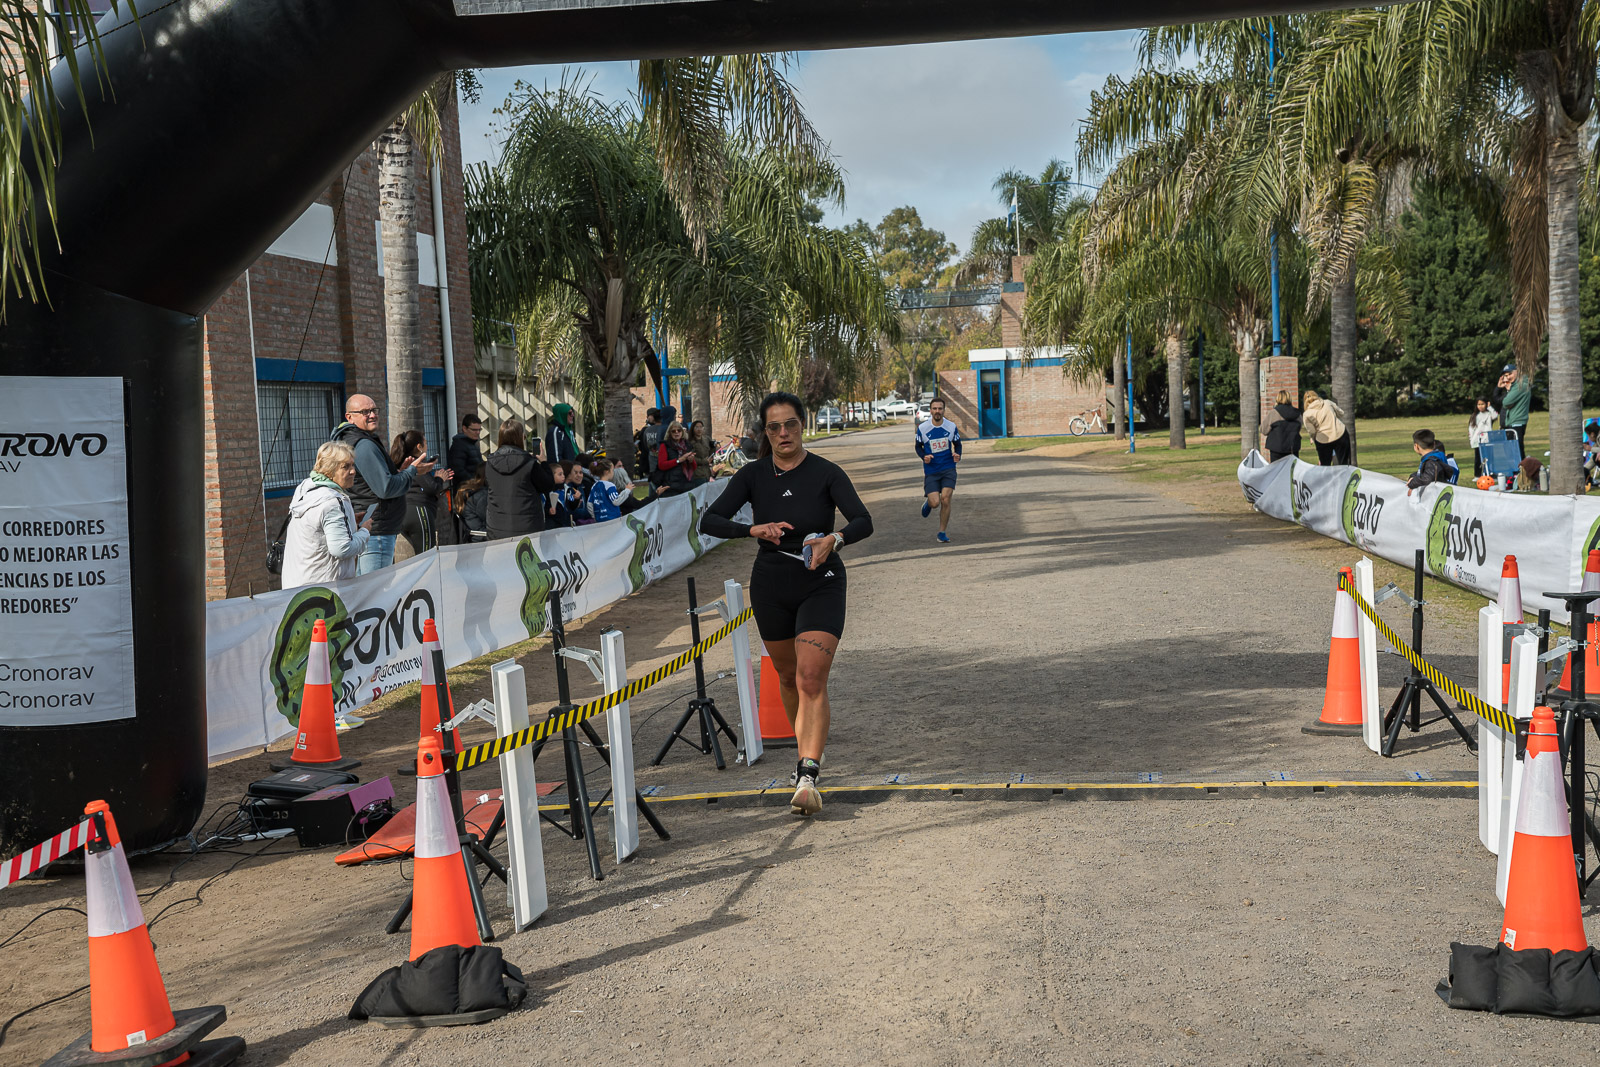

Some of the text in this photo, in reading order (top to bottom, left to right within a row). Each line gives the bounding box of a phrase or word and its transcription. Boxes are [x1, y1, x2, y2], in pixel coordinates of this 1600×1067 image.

[932, 441, 947, 450] 512
[2, 519, 105, 537] CORREDORES
[0, 544, 120, 563] O MEJORAR LAS
[53, 572, 74, 588] DE
[77, 569, 106, 587] LOS
